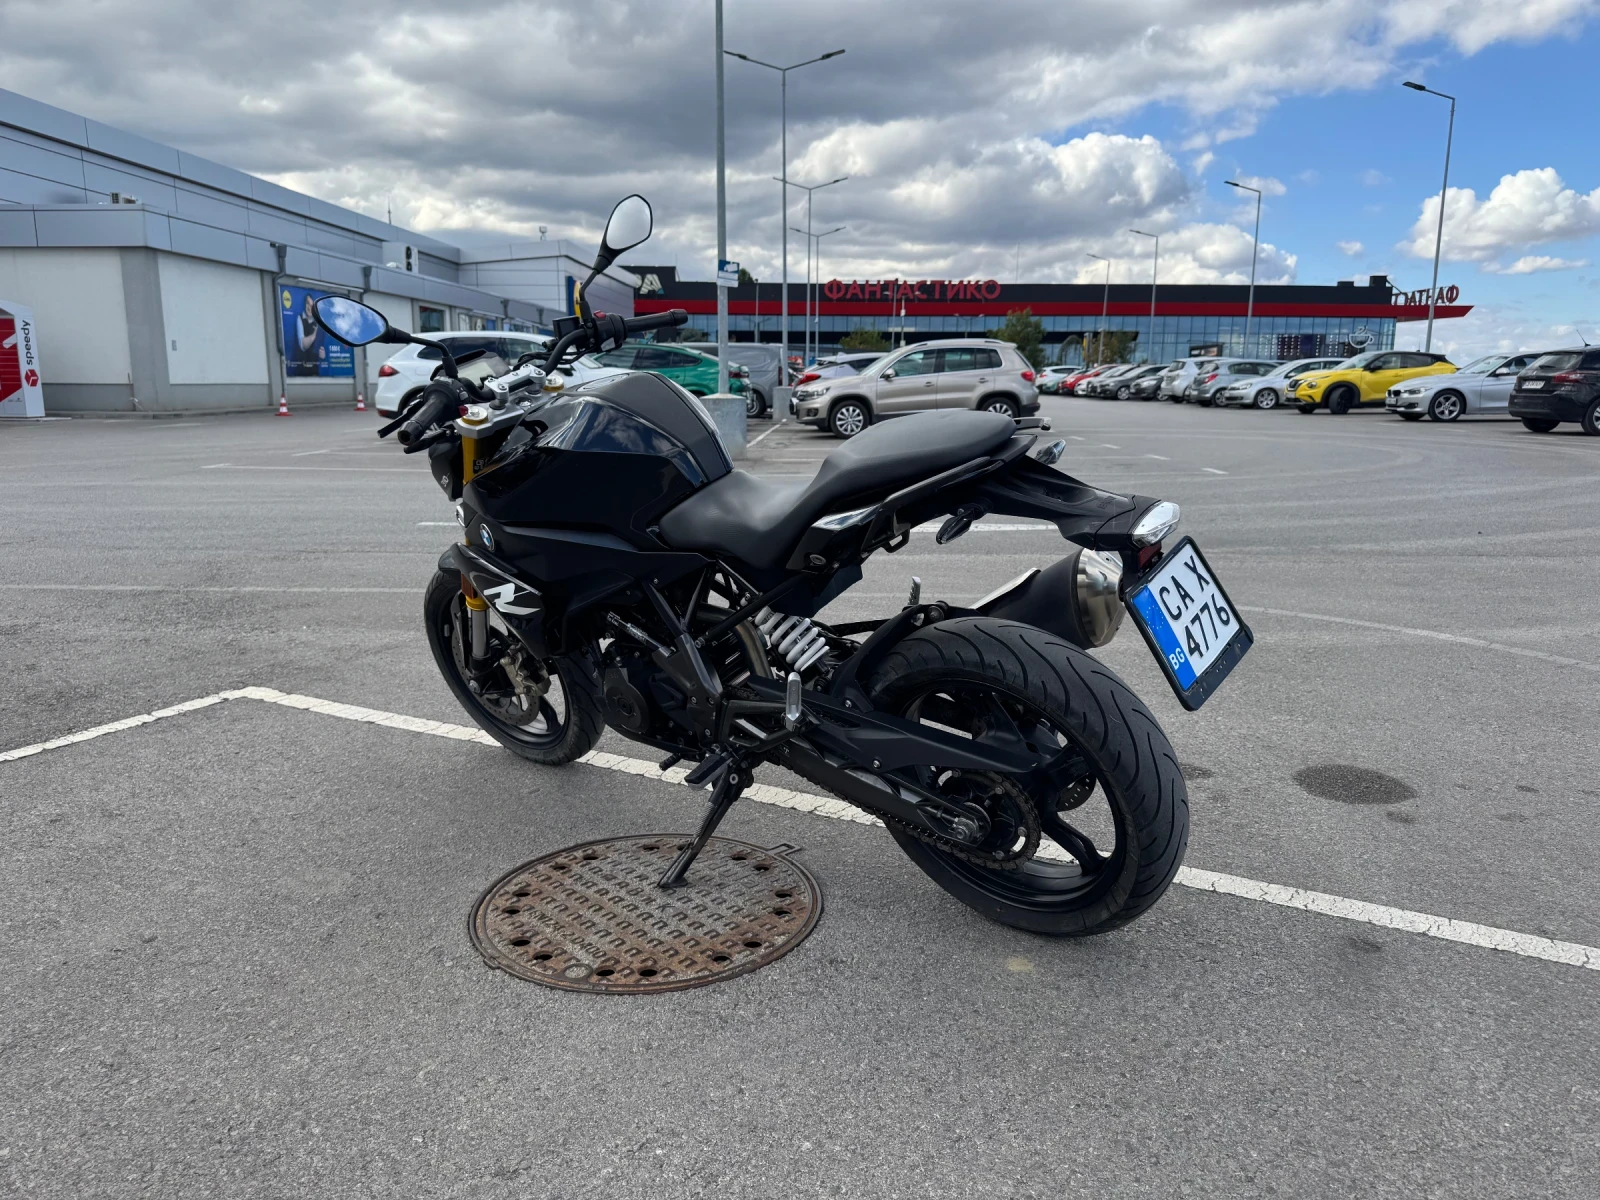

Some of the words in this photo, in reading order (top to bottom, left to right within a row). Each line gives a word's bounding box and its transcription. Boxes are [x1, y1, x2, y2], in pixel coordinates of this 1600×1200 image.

[824, 279, 1001, 300] ФАНТАСТИКО
[21, 320, 34, 365] speedy
[1159, 575, 1195, 621] CA
[1184, 555, 1210, 593] X
[1184, 593, 1231, 659] 4776
[1169, 647, 1186, 670] BG
